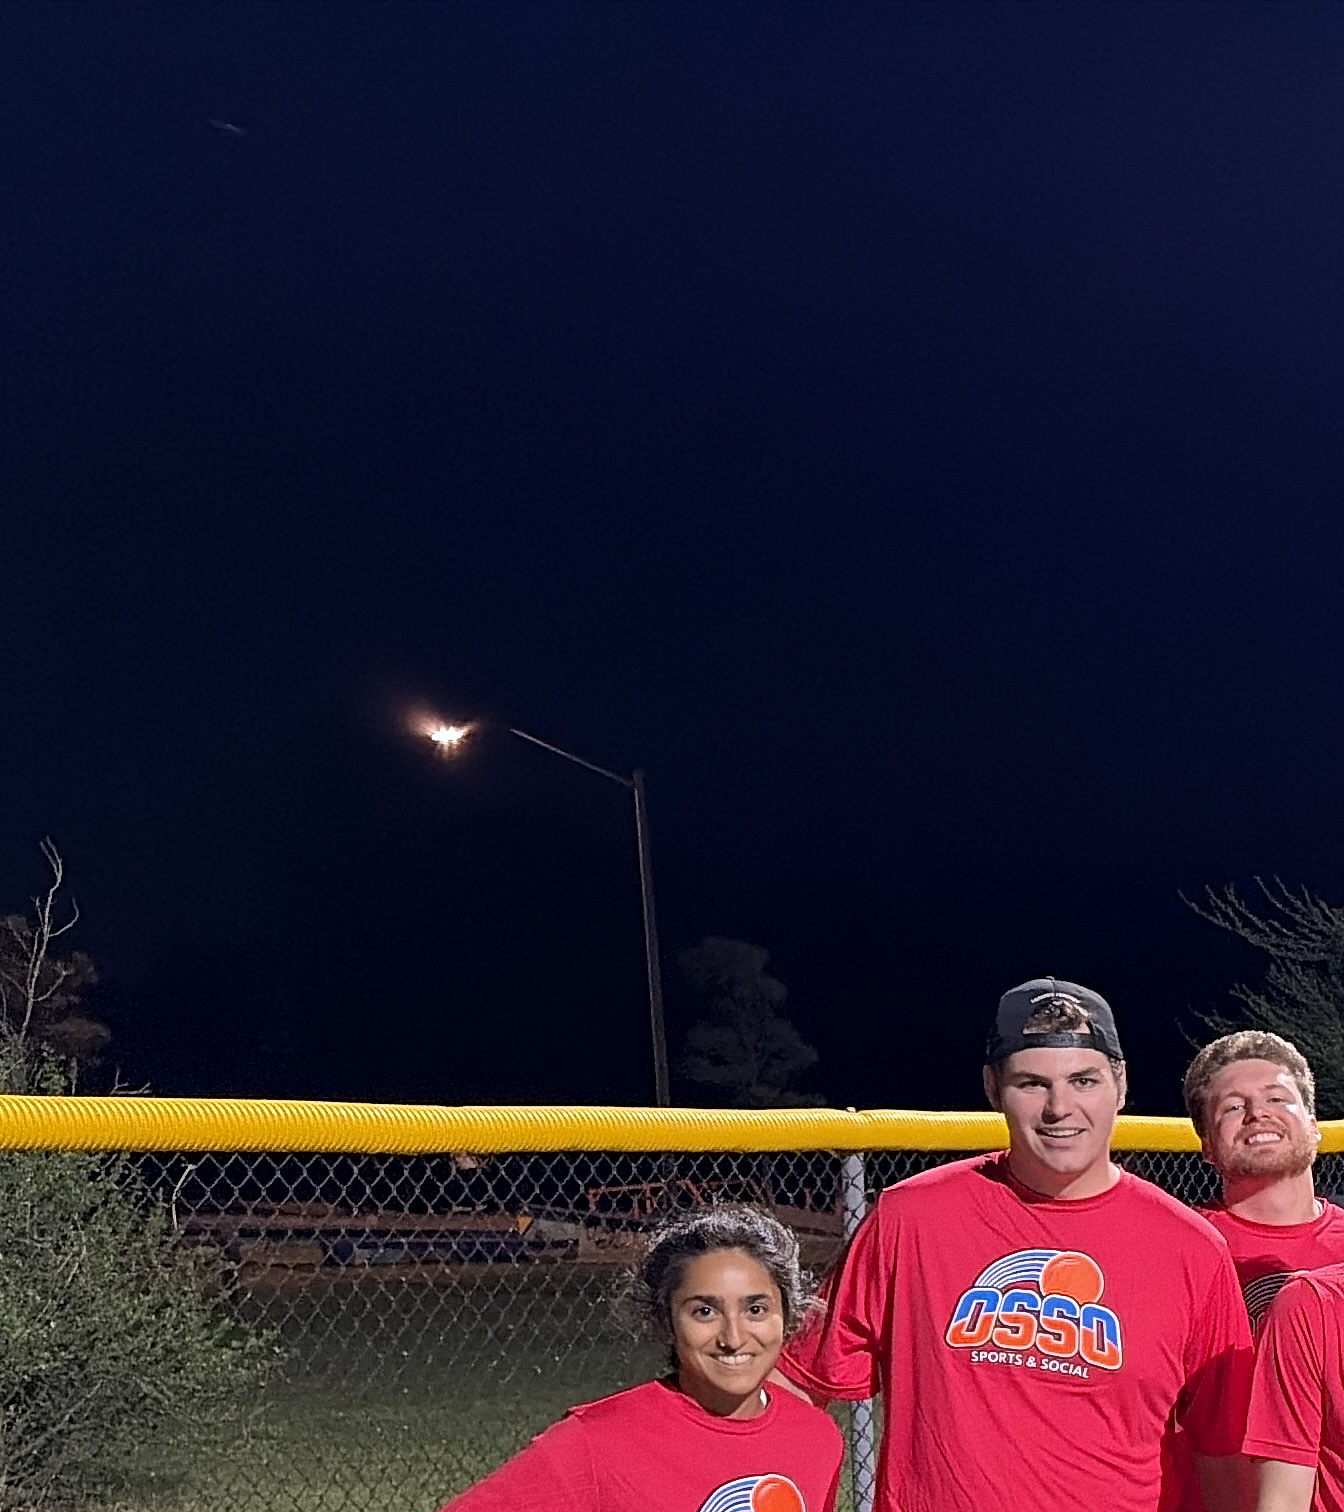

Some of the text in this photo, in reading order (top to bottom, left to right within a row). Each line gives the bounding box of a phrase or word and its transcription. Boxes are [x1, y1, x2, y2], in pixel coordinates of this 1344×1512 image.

[945, 1287, 1123, 1370] OSSO
[970, 1350, 1090, 1379] SPORTS & SOCIAL
